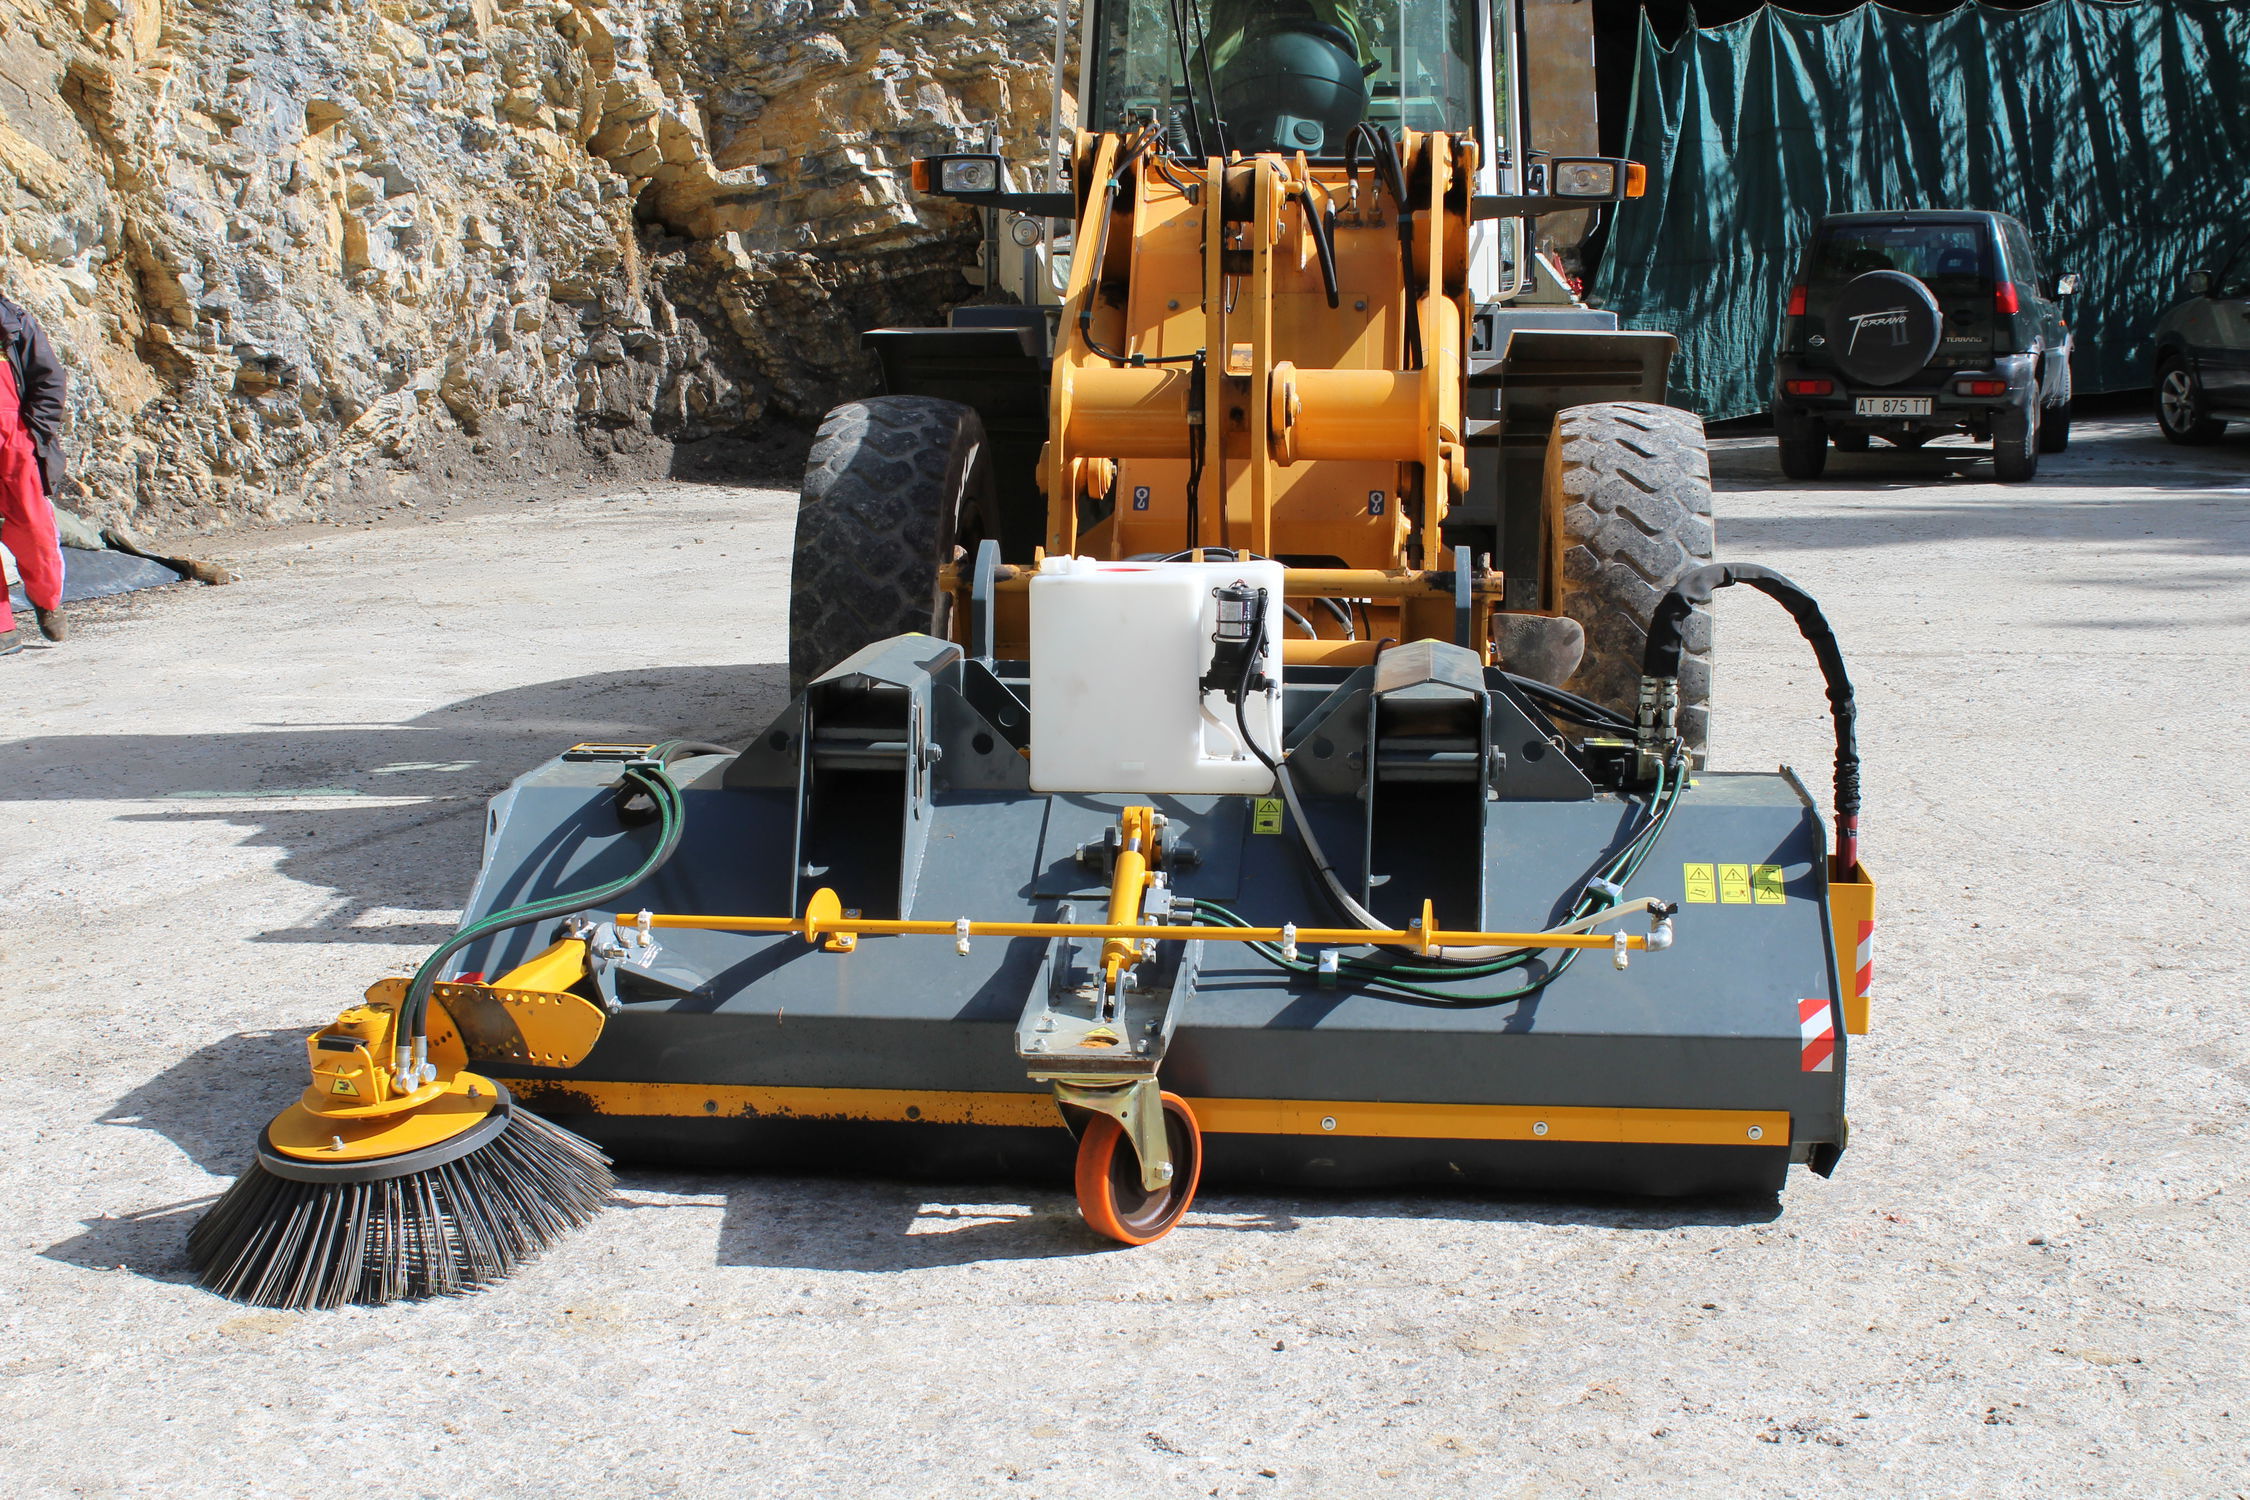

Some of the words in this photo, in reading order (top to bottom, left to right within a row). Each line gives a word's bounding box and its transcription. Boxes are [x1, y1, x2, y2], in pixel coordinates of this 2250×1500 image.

[1859, 400, 1874, 413] AT
[1883, 400, 1907, 413] 875
[1914, 400, 1928, 413] TT
